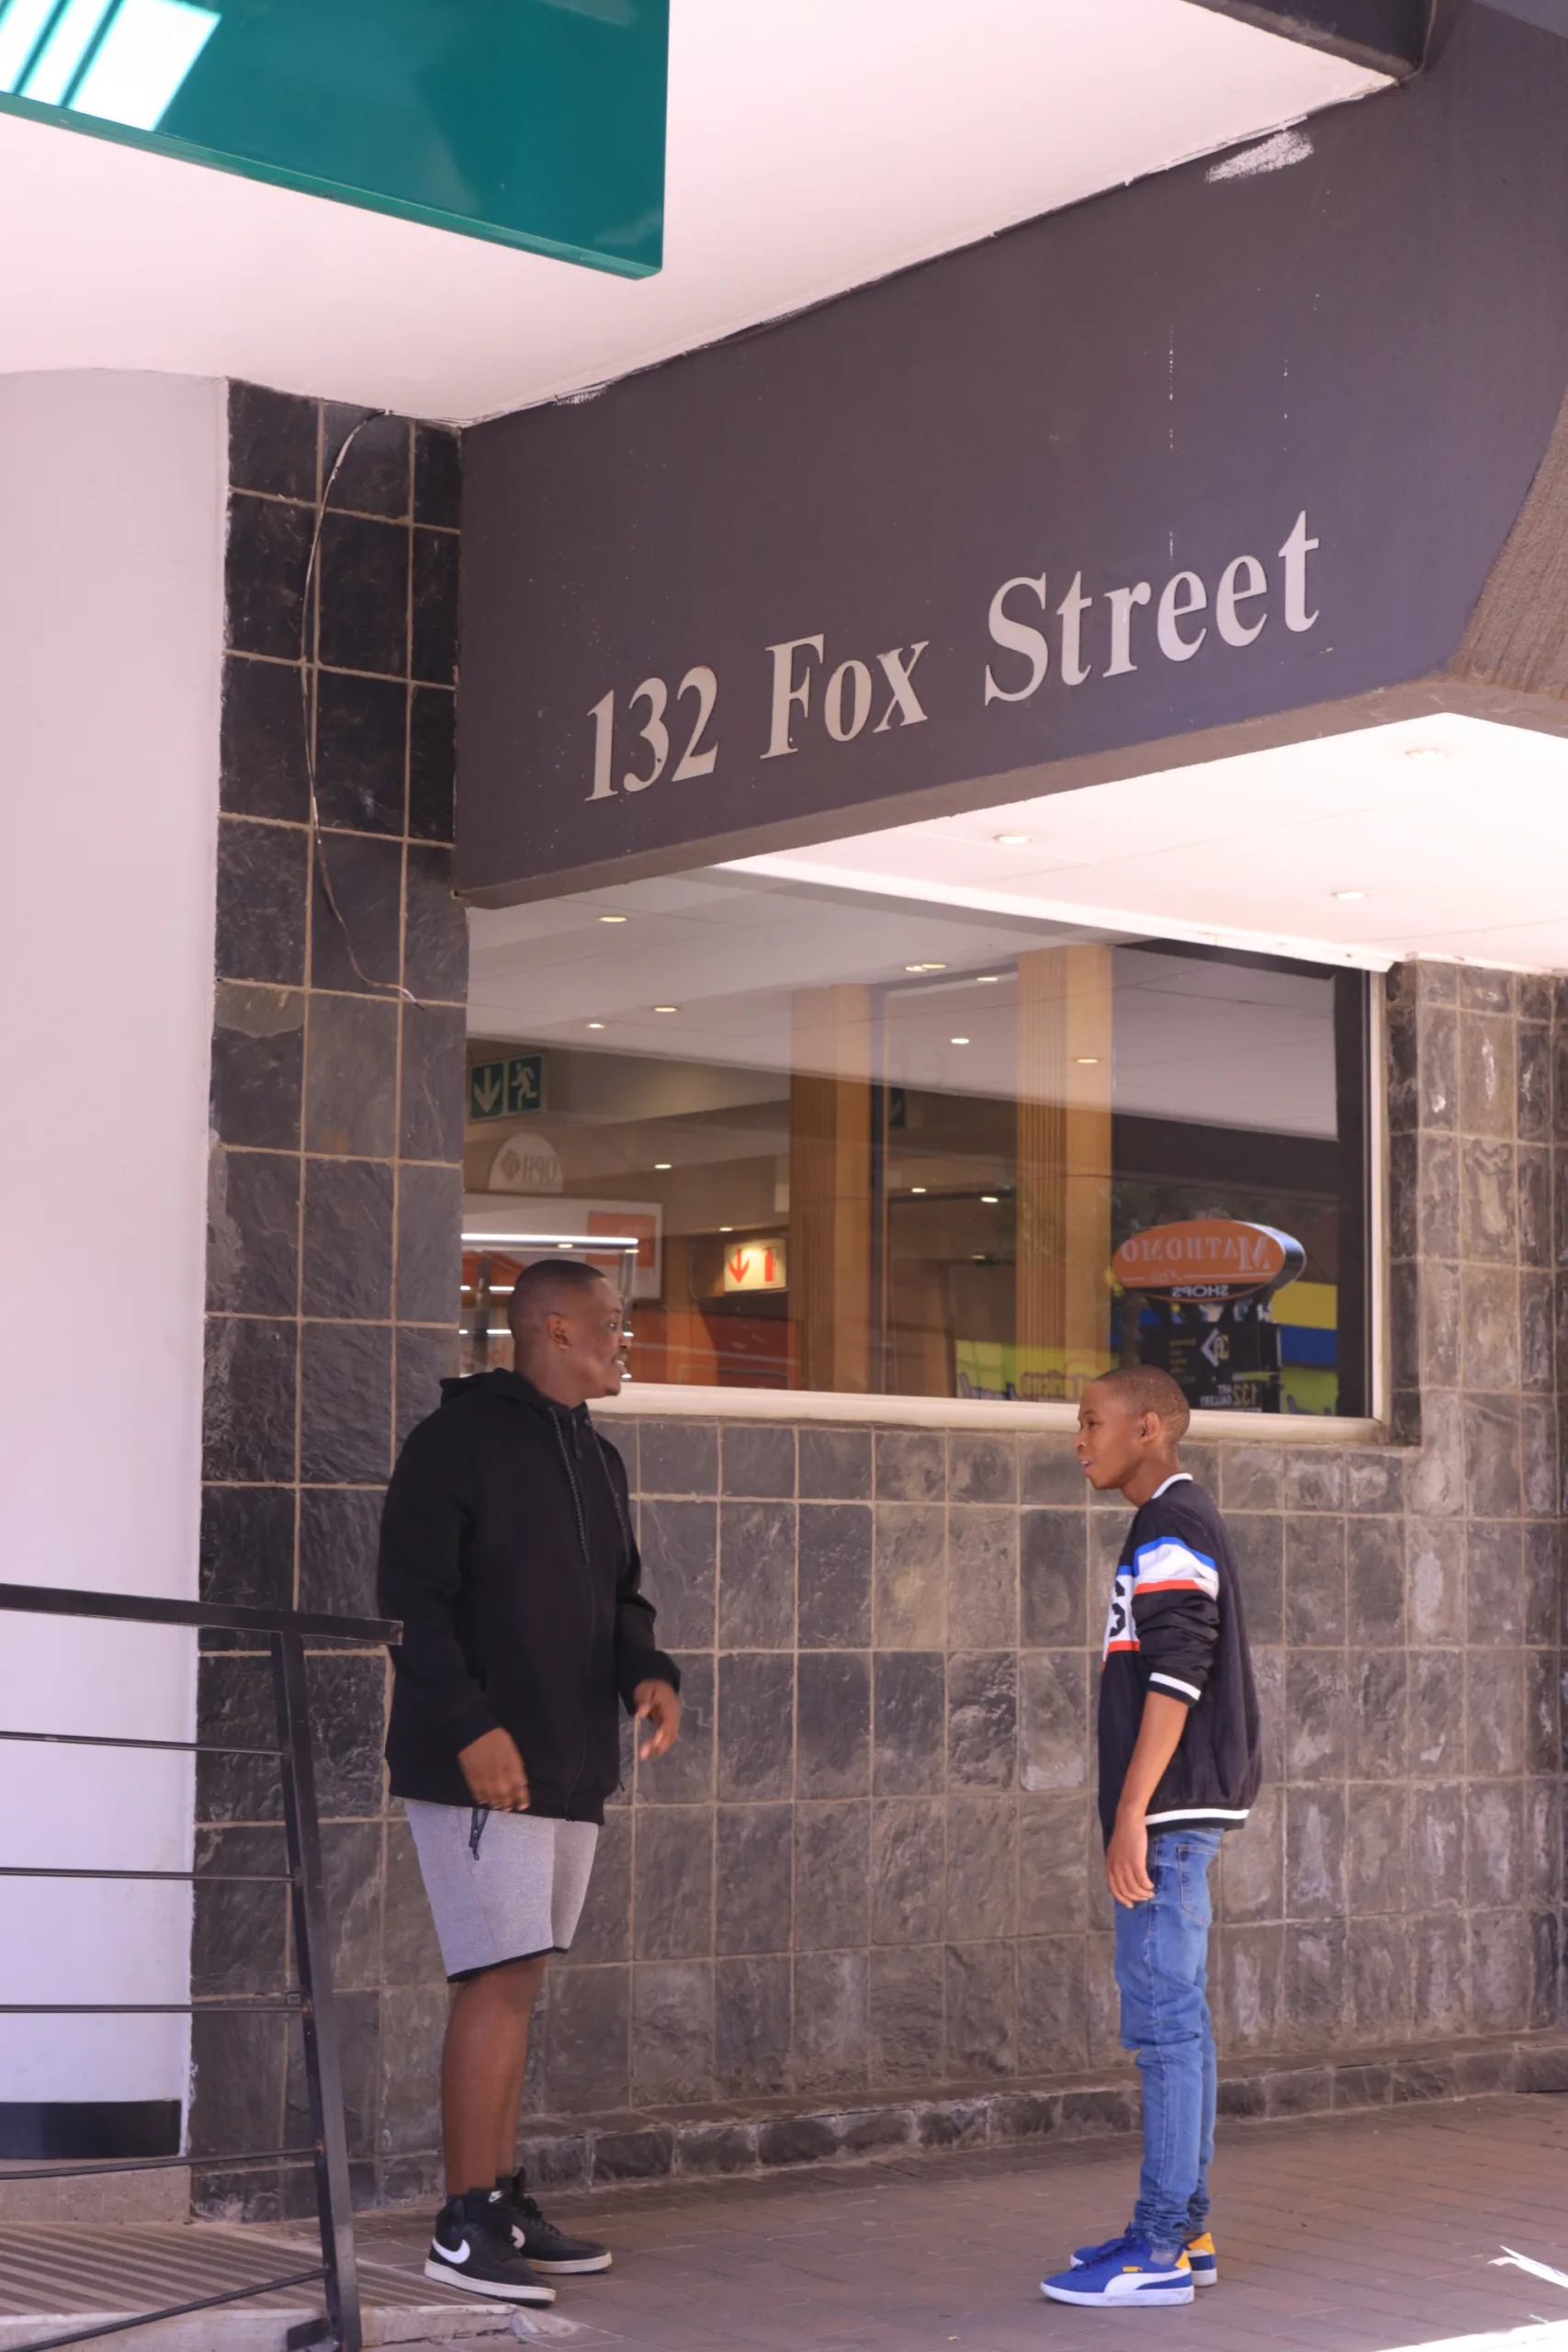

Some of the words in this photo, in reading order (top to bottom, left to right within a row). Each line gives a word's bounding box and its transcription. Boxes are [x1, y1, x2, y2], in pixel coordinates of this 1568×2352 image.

[584, 667, 719, 801] 132
[760, 633, 930, 760] Fox
[985, 510, 1321, 707] Street
